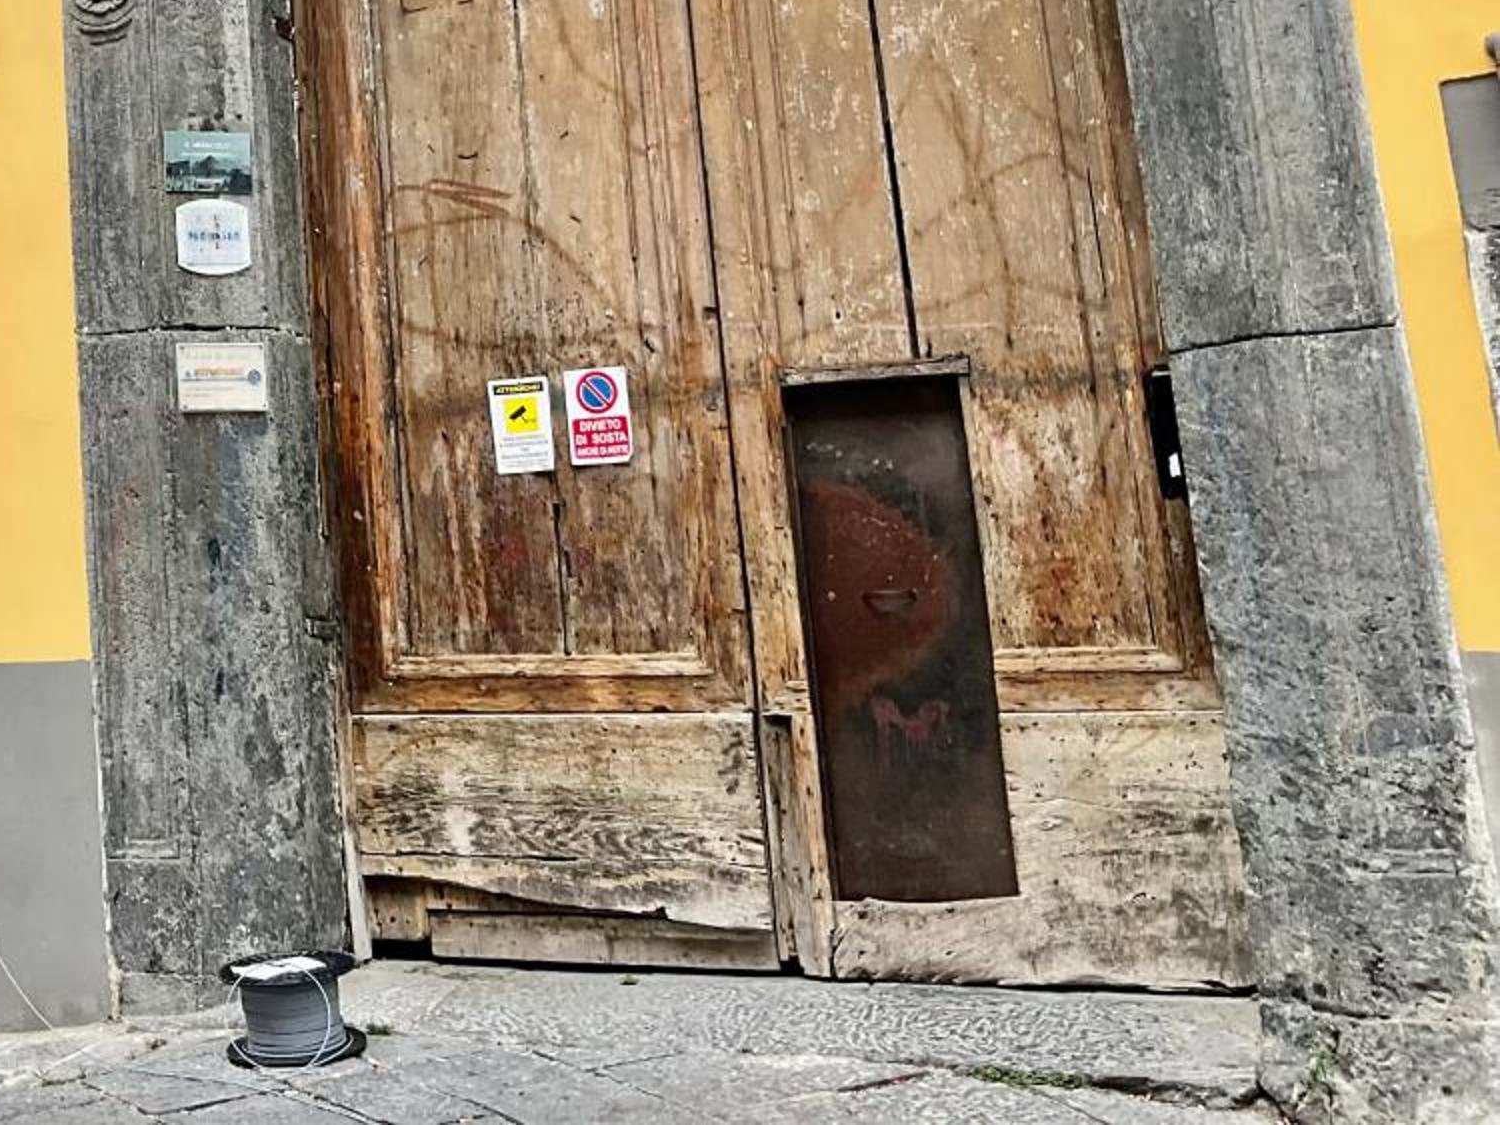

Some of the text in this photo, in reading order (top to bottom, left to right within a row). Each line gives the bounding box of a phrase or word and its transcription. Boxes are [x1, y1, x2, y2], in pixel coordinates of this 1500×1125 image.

[579, 419, 621, 432] DIVIETO
[576, 432, 627, 445] DI SOSTA
